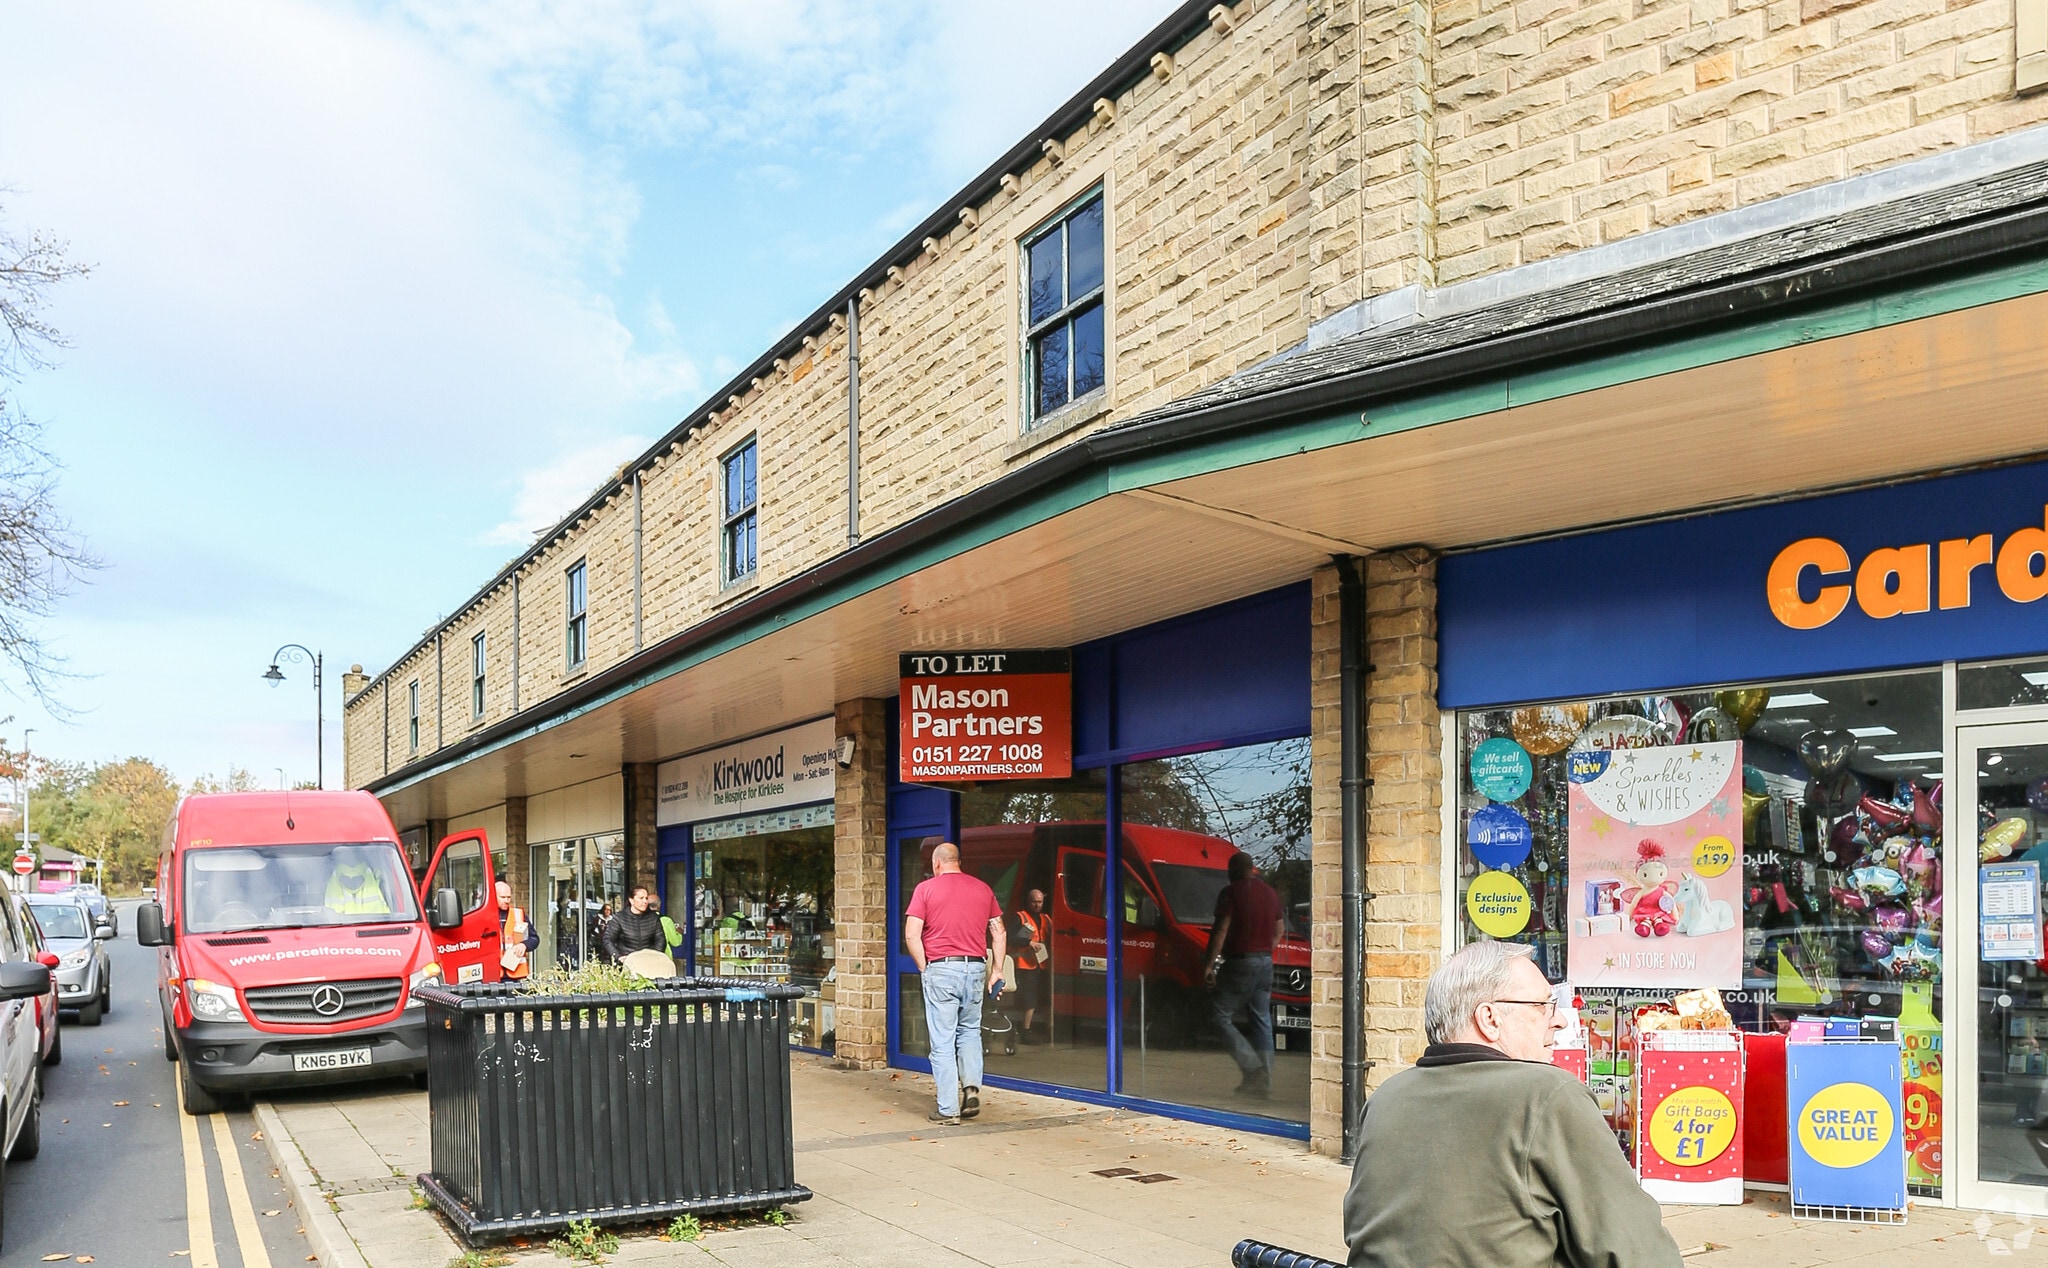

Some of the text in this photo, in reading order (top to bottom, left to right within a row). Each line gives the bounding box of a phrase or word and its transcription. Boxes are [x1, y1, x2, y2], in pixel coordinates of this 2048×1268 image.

[1767, 503, 2048, 630] Card
[911, 654, 1006, 674] TO LET
[911, 684, 1009, 709] Mason
[911, 711, 1043, 738] Partners
[802, 751, 827, 767] Opening
[912, 743, 1043, 764] 0151 227 1008
[1485, 751, 1519, 763] We sell
[713, 745, 784, 791] Kirkwood
[912, 763, 1043, 776] MASONPARTNERS.COM
[1479, 762, 1524, 777] giftcards
[1573, 762, 1601, 774] NEW
[1616, 758, 1691, 798] Sparkles
[713, 782, 784, 805] The Hospice for Kirklees
[1616, 787, 1690, 812] & WISHES
[1506, 832, 1518, 841] Pay
[1696, 853, 1729, 865] £1.99
[1475, 892, 1523, 902] Exclusive
[1479, 904, 1518, 916] designs
[460, 941, 481, 950] Delivery
[229, 946, 402, 967] www.parcelforce.com
[1618, 951, 1696, 970] IN STORE NOW
[300, 1051, 366, 1068] KN66 BVK
[1665, 1105, 1728, 1121] Gift Bags
[1811, 1109, 1879, 1124] GREAT
[1673, 1119, 1684, 1133] 4
[1688, 1118, 1714, 1134] for
[1813, 1126, 1879, 1141] VALUE
[1676, 1137, 1705, 1159] £1
